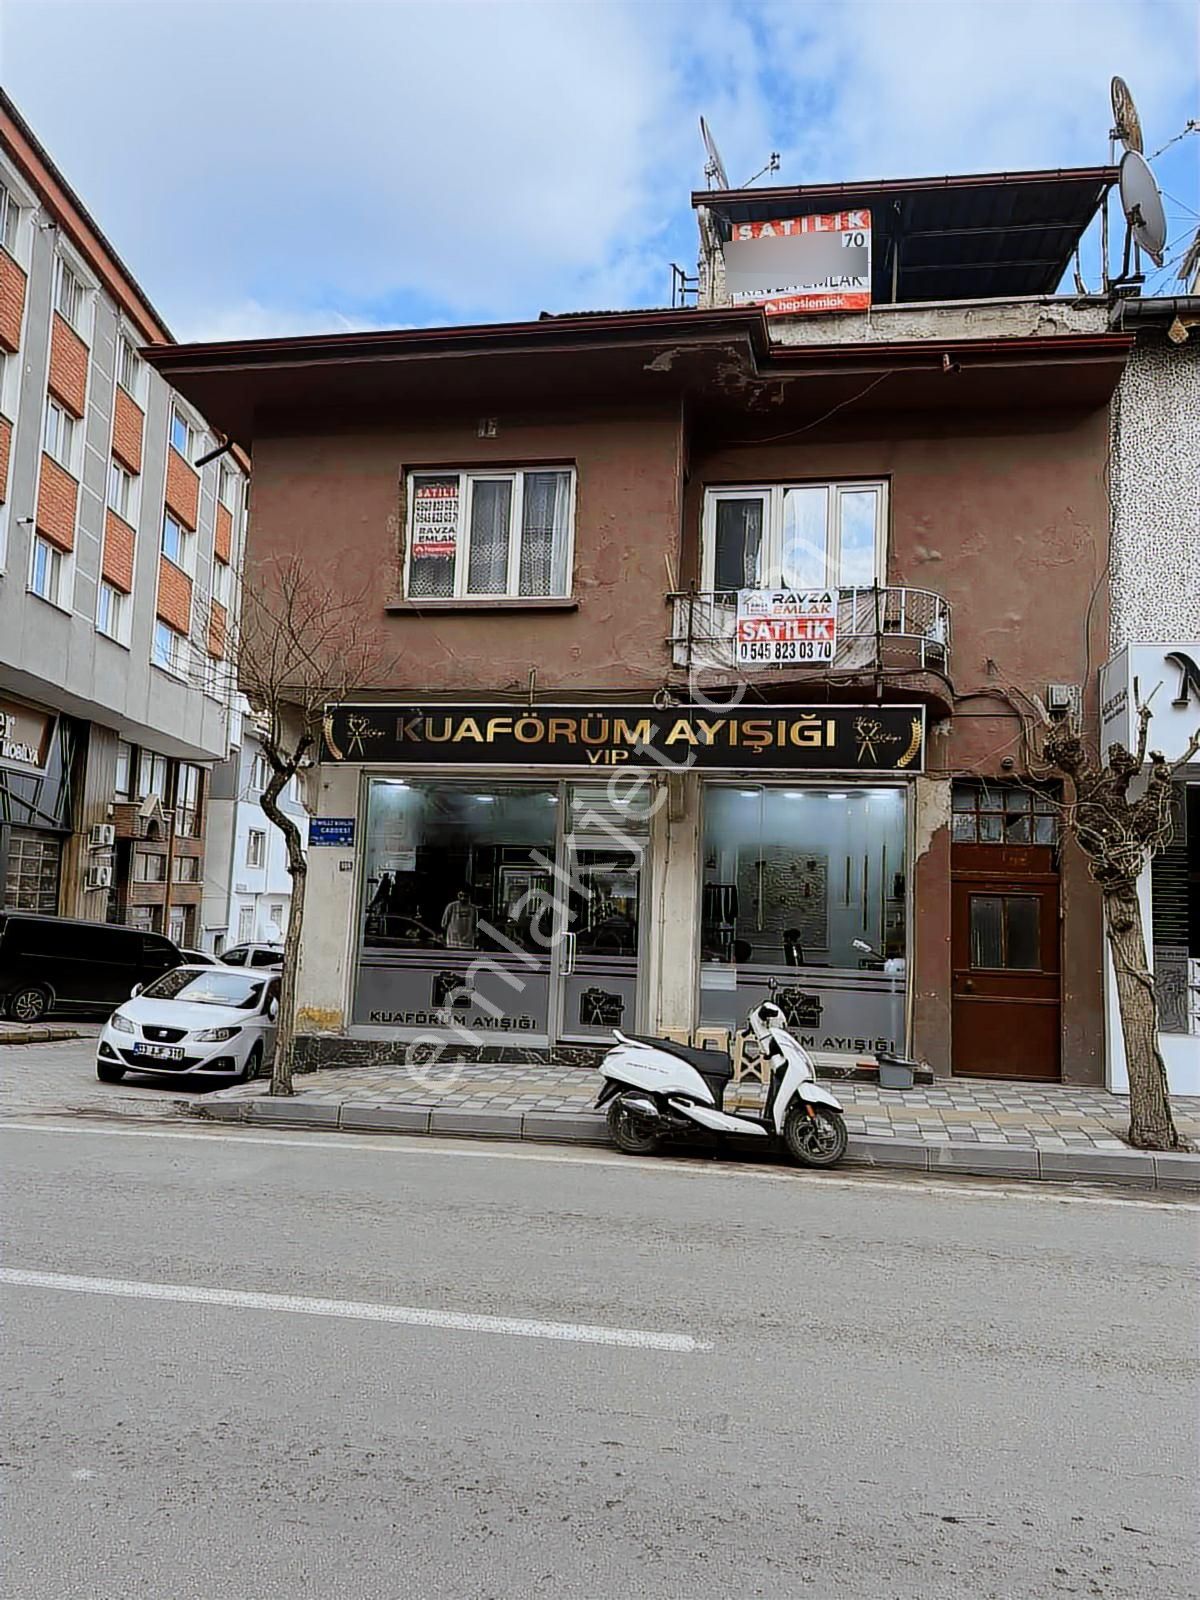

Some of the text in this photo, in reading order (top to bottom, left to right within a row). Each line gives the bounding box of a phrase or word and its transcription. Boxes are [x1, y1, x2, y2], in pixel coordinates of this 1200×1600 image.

[738, 211, 866, 241] SATILIK
[844, 232, 865, 248] 70
[778, 296, 844, 311] hepsiemlak
[772, 592, 832, 604] RAVZA
[772, 604, 831, 614] EMLAK
[742, 620, 830, 641] SATILIK
[740, 641, 832, 660] 0 545 823 03 70
[396, 711, 650, 745] KUAFÖRÜM
[665, 713, 836, 753] AYIŞIĞI
[586, 749, 629, 765] VIP
[472, 1015, 536, 1031] AYIŞIĞI
[822, 1037, 895, 1054] AYIŞIĞI
